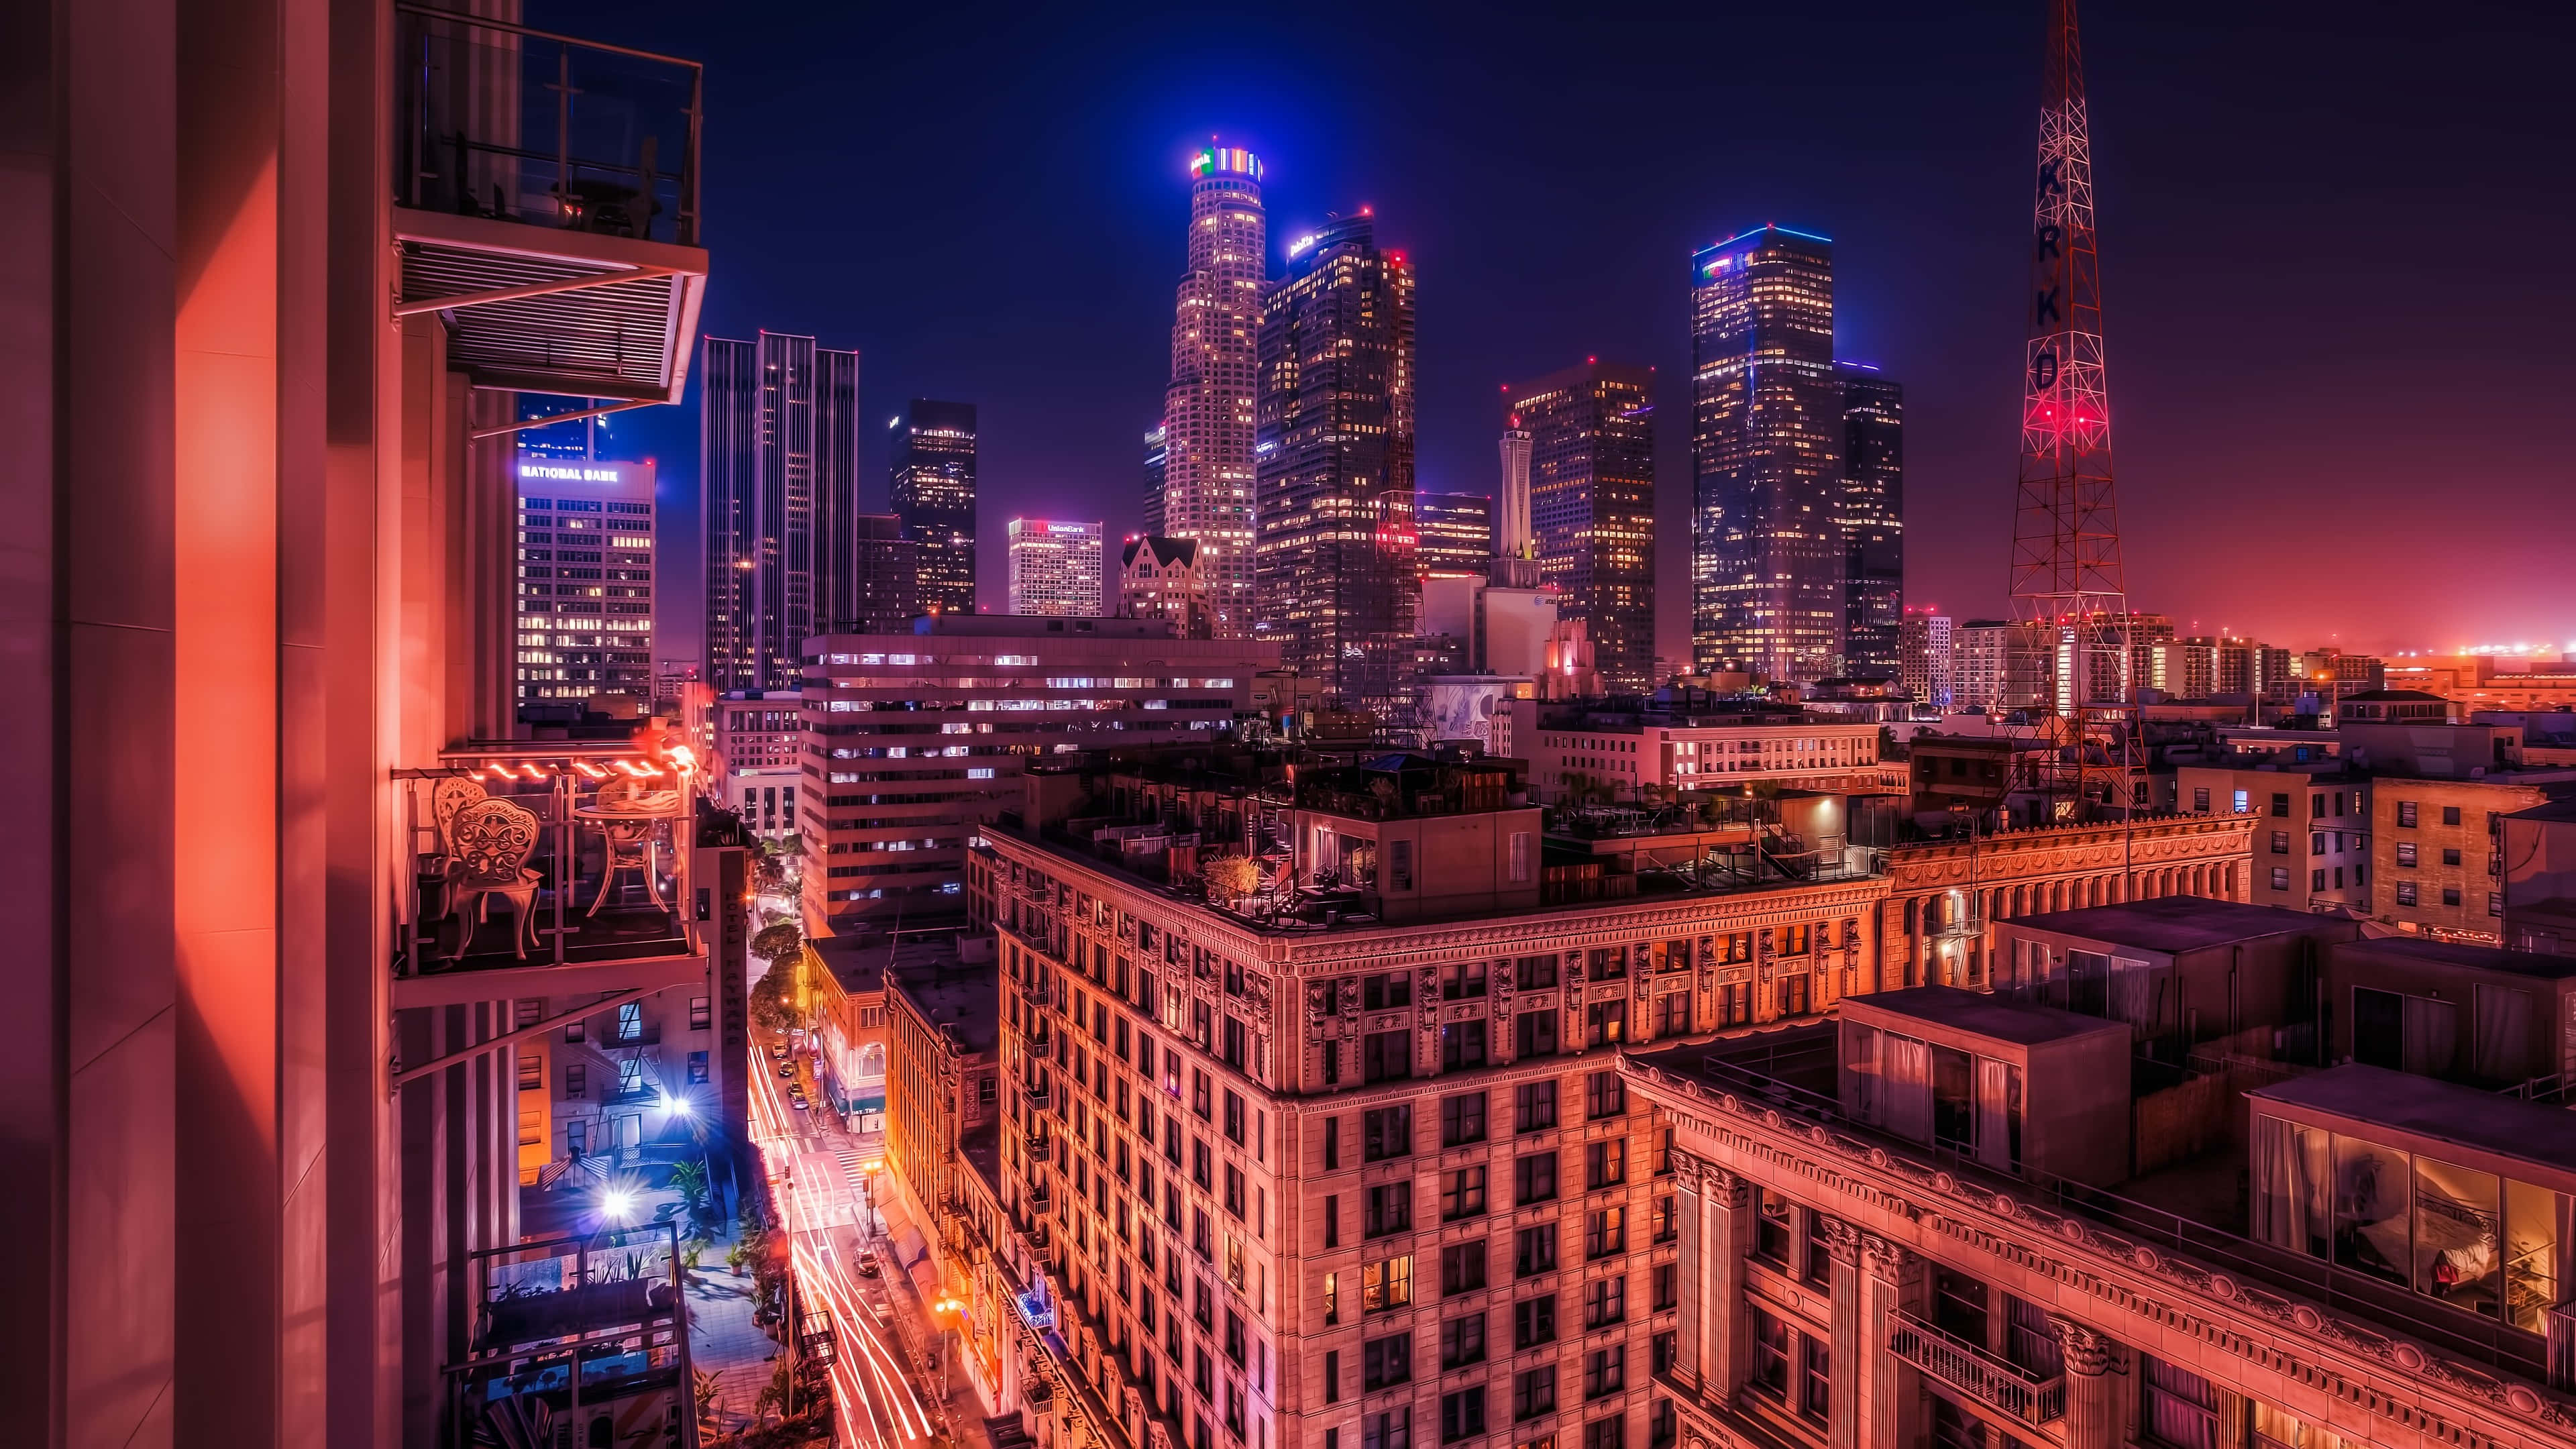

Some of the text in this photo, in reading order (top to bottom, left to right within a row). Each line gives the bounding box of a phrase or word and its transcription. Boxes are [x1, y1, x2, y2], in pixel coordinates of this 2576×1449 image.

[2036, 158, 2063, 390] KRKD
[521, 466, 618, 482] NATIONAL BANK
[726, 892, 739, 945] HOTEL
